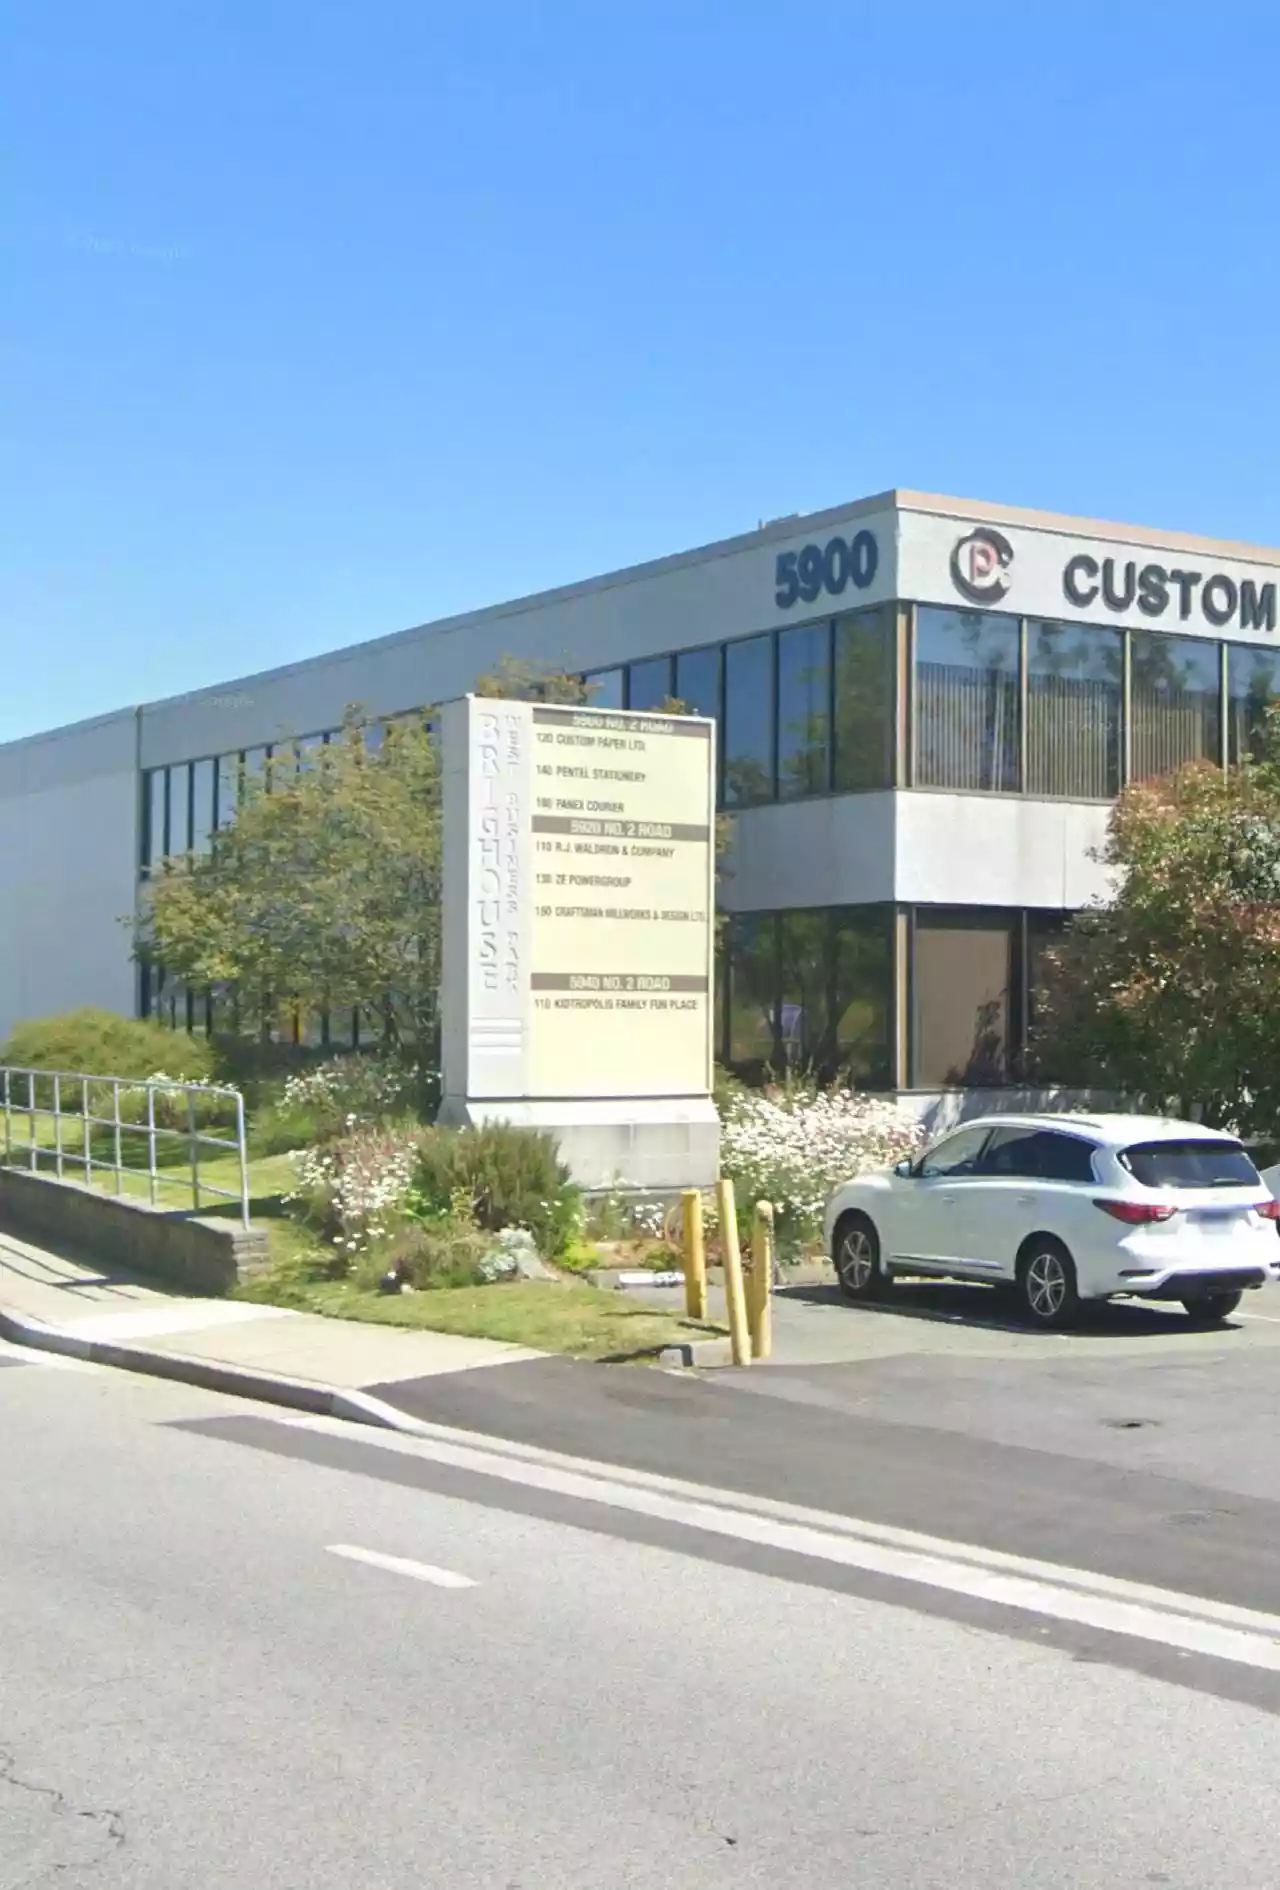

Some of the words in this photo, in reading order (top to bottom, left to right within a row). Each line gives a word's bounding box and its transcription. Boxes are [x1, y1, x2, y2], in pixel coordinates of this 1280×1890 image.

[775, 529, 878, 609] 5900
[1063, 553, 1276, 631] CUSTOM
[536, 732, 553, 744] 120
[556, 733, 595, 747] CUSTOM
[597, 736, 626, 750] PAPER
[556, 765, 589, 780] PENTEL
[592, 767, 647, 783] STATIONERY
[586, 800, 625, 813] COURIER
[604, 821, 624, 836] NO.
[627, 823, 636, 836] 2
[638, 823, 672, 838] ROAD
[574, 843, 619, 856] WALDRON
[630, 845, 676, 858] COMPANY
[603, 976, 624, 989] NO.
[626, 976, 636, 990] 2
[637, 976, 671, 990] ROAD
[616, 998, 647, 1010] FAMILY
[649, 998, 667, 1010] FUN
[669, 999, 698, 1010] PLACE
